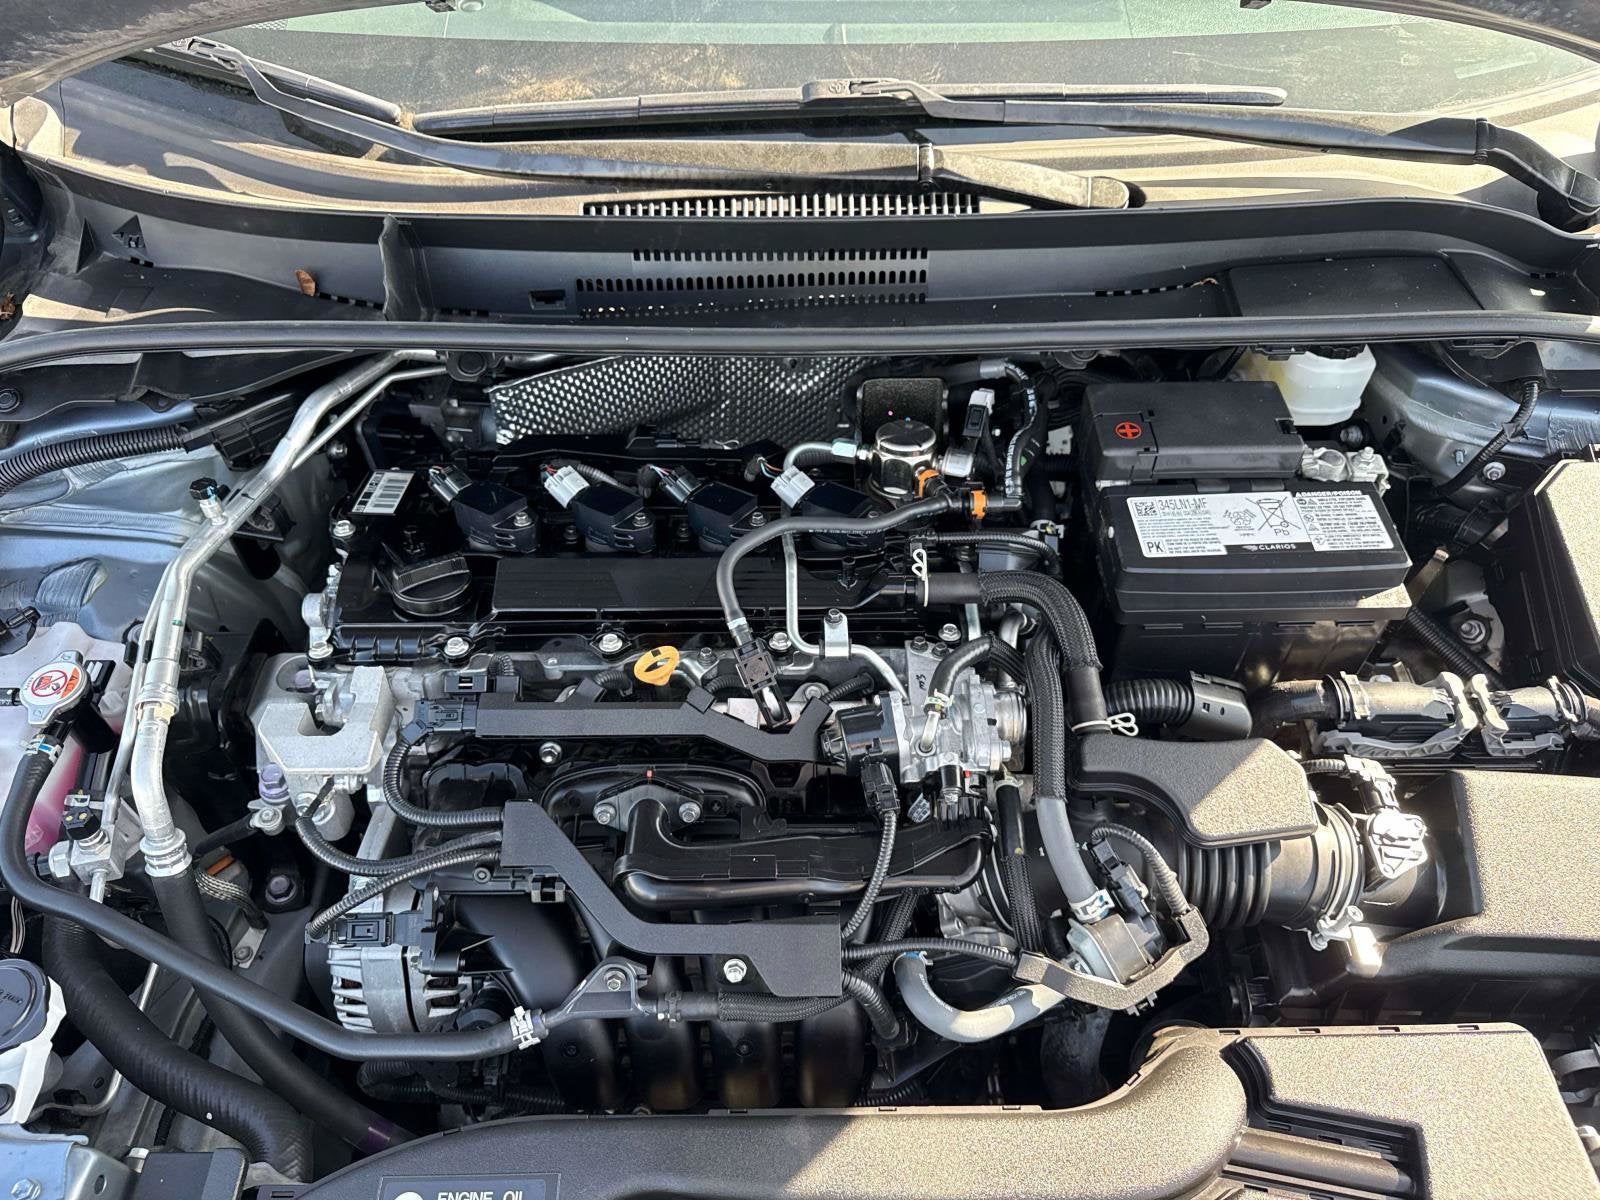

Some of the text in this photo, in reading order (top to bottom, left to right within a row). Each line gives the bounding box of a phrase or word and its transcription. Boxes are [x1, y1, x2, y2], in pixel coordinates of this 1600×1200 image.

[1274, 528, 1290, 536] Pb
[1147, 541, 1164, 553] PK
[438, 1190, 523, 1200] ENGINE OIL
